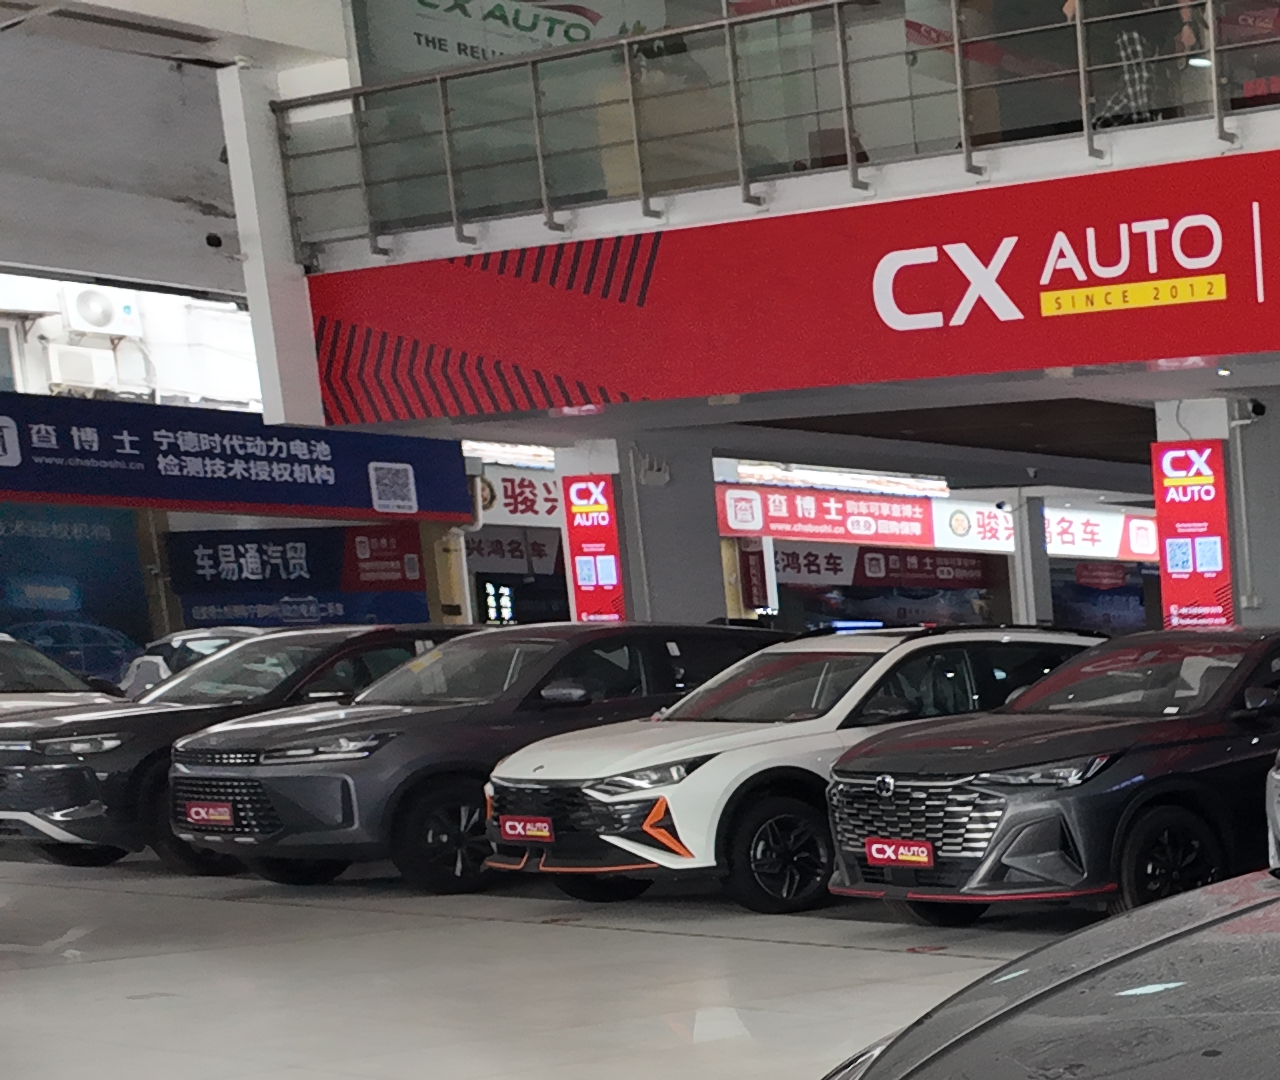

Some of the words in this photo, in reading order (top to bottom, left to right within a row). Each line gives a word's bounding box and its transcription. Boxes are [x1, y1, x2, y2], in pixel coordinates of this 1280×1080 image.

[482, 3, 591, 43] AUTO
[413, 32, 448, 53] THE
[873, 236, 1025, 332] CX
[1040, 214, 1222, 285] AUTO
[1055, 290, 1128, 310] SINCE
[1153, 281, 1215, 300] 2012
[29, 423, 141, 455] 查博士
[153, 429, 332, 461] 宁德时代动力电池
[157, 454, 335, 485] 检测技术授权机构
[1162, 448, 1213, 478] CX
[569, 481, 607, 505] CX
[1165, 485, 1215, 503] AUTO
[574, 511, 609, 526] AUTO
[767, 494, 843, 520] 查博士
[194, 543, 311, 582] 车易通汽贸
[774, 550, 844, 575] 鸿名车
[505, 821, 525, 835] CX
[526, 822, 549, 832] AUTO
[871, 844, 896, 860] CX
[898, 846, 928, 857] AUTO
